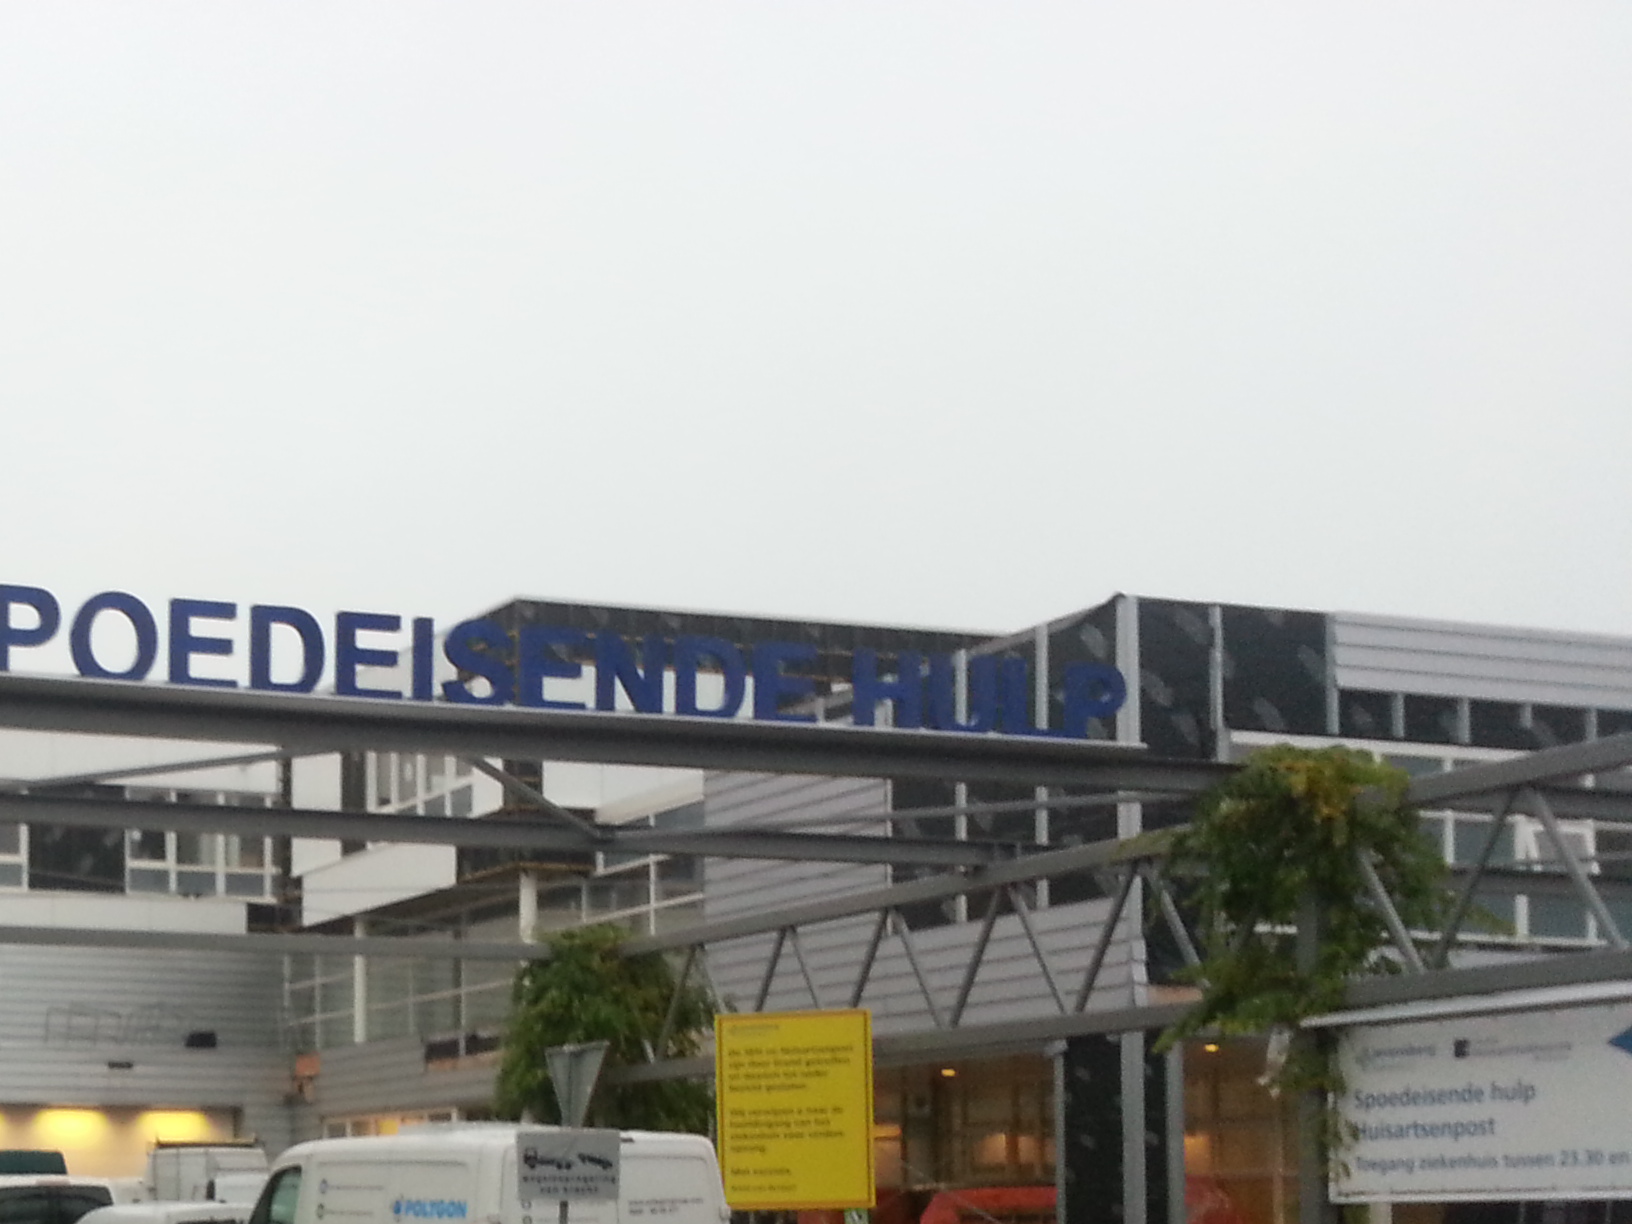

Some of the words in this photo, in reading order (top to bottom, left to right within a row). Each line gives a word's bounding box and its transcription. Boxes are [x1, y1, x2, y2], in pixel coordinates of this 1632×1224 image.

[852, 648, 1128, 742] HULP
[1354, 1081, 1485, 1109] Spoedeisende
[1490, 1078, 1536, 1105] hulp
[1358, 1117, 1495, 1142] Huisartsenpost
